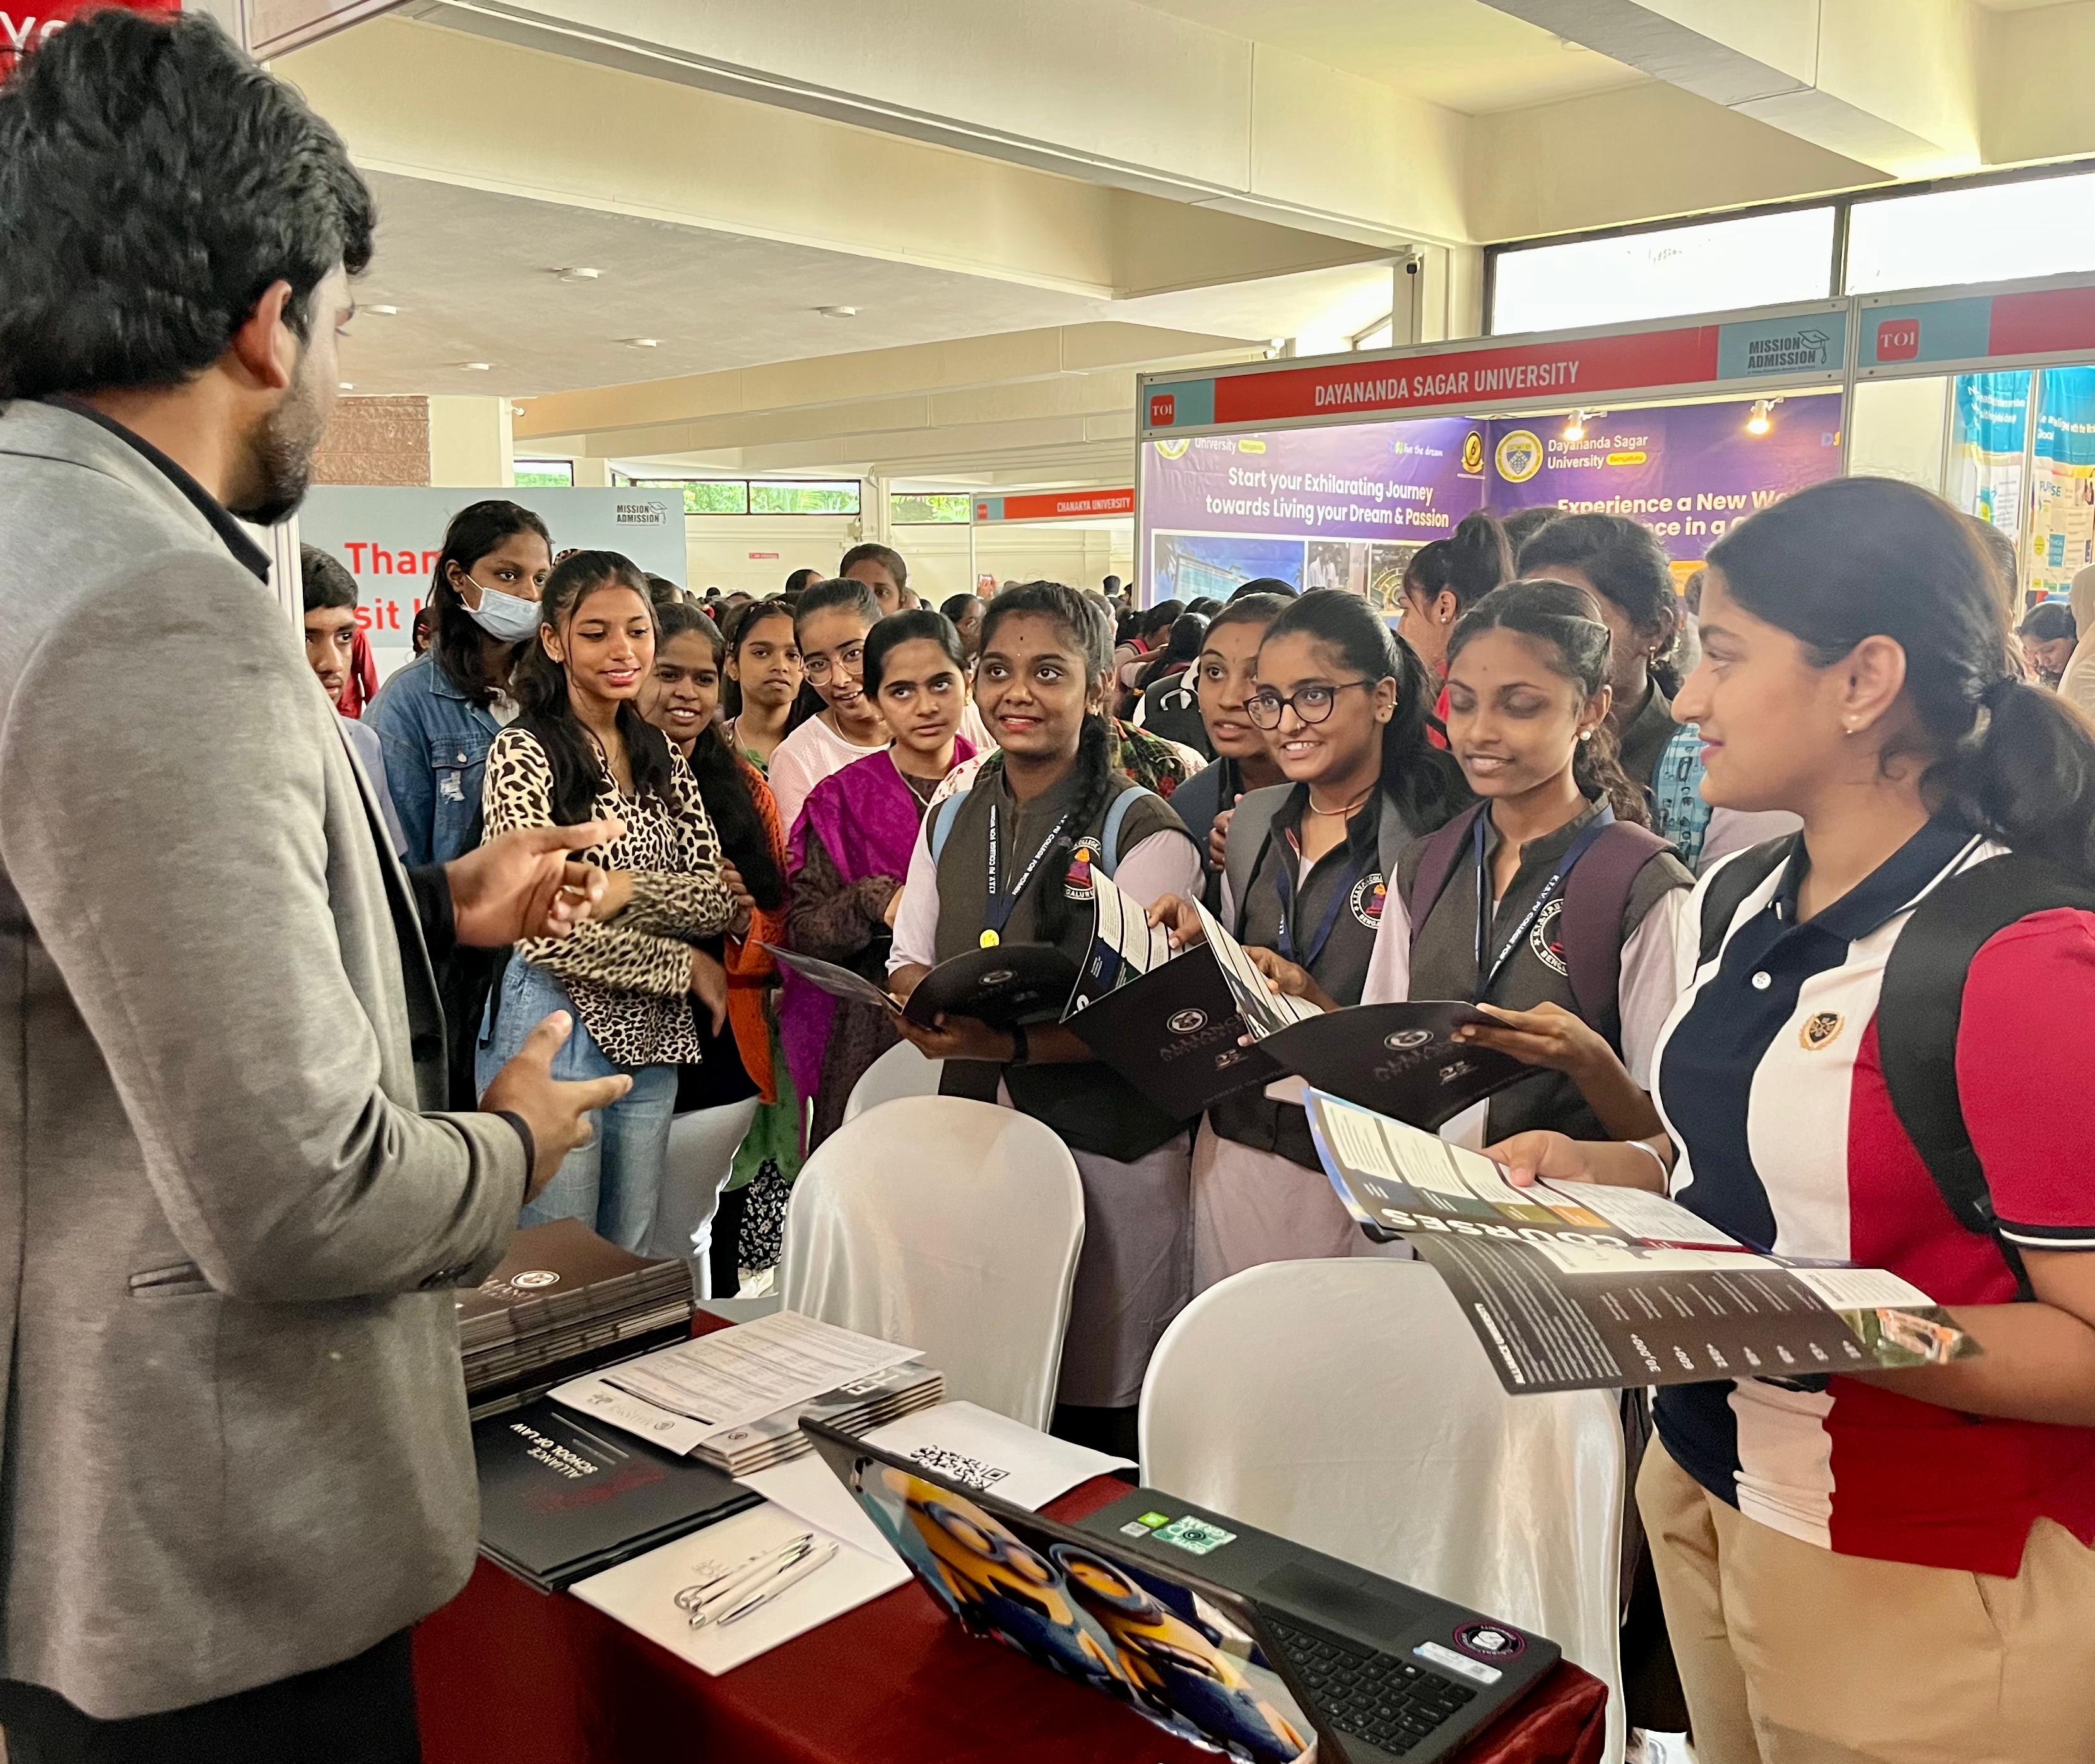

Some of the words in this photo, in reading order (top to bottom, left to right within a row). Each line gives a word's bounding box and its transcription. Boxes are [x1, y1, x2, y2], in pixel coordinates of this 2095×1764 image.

[1749, 337, 1800, 354] MISSION
[1880, 331, 1916, 348] TOI
[1747, 350, 1816, 368] ADMISSION
[1315, 378, 1409, 406] DAYANANDA
[1413, 371, 1468, 397] SAGAR
[1474, 361, 1579, 392] UNIVERSITY
[1152, 404, 1172, 416] TOI
[1195, 437, 1237, 455] University
[1548, 436, 1611, 454] Dayananda
[1614, 435, 1648, 450] Sagar
[1547, 454, 1605, 470] University
[1229, 467, 1266, 488] Start
[1270, 473, 1302, 494] your
[1305, 473, 1383, 502] Exhilarating
[1386, 481, 1434, 506] Journey
[617, 505, 649, 514] MISSION
[1056, 499, 1091, 512] CHANAKYA
[1092, 497, 1131, 510] UNIVERSITY
[1206, 494, 1270, 517] towards
[1273, 497, 1314, 525] Living
[1317, 504, 1347, 526] your
[1350, 505, 1392, 524] Dream
[1395, 507, 1403, 524] &
[1406, 508, 1450, 528] Passion
[1677, 497, 1692, 512] a
[1696, 492, 1747, 510] New
[617, 514, 659, 522] ADMISSION
[1686, 517, 1706, 536] in
[1710, 520, 1725, 535] a
[344, 543, 441, 574] Than
[354, 598, 400, 630] sit
[1034, 833, 1055, 859] COLLEGE
[1027, 859, 1038, 872] FOR
[1509, 912, 1534, 944] COLLEGE
[1631, 1334, 1661, 1372] 30,000+
[1673, 1346, 1694, 1370] 600+
[510, 1424, 540, 1439] LAW
[533, 1437, 554, 1448] OF
[527, 1447, 583, 1479] ALLIANCE
[552, 1445, 598, 1474] SCHOOL
